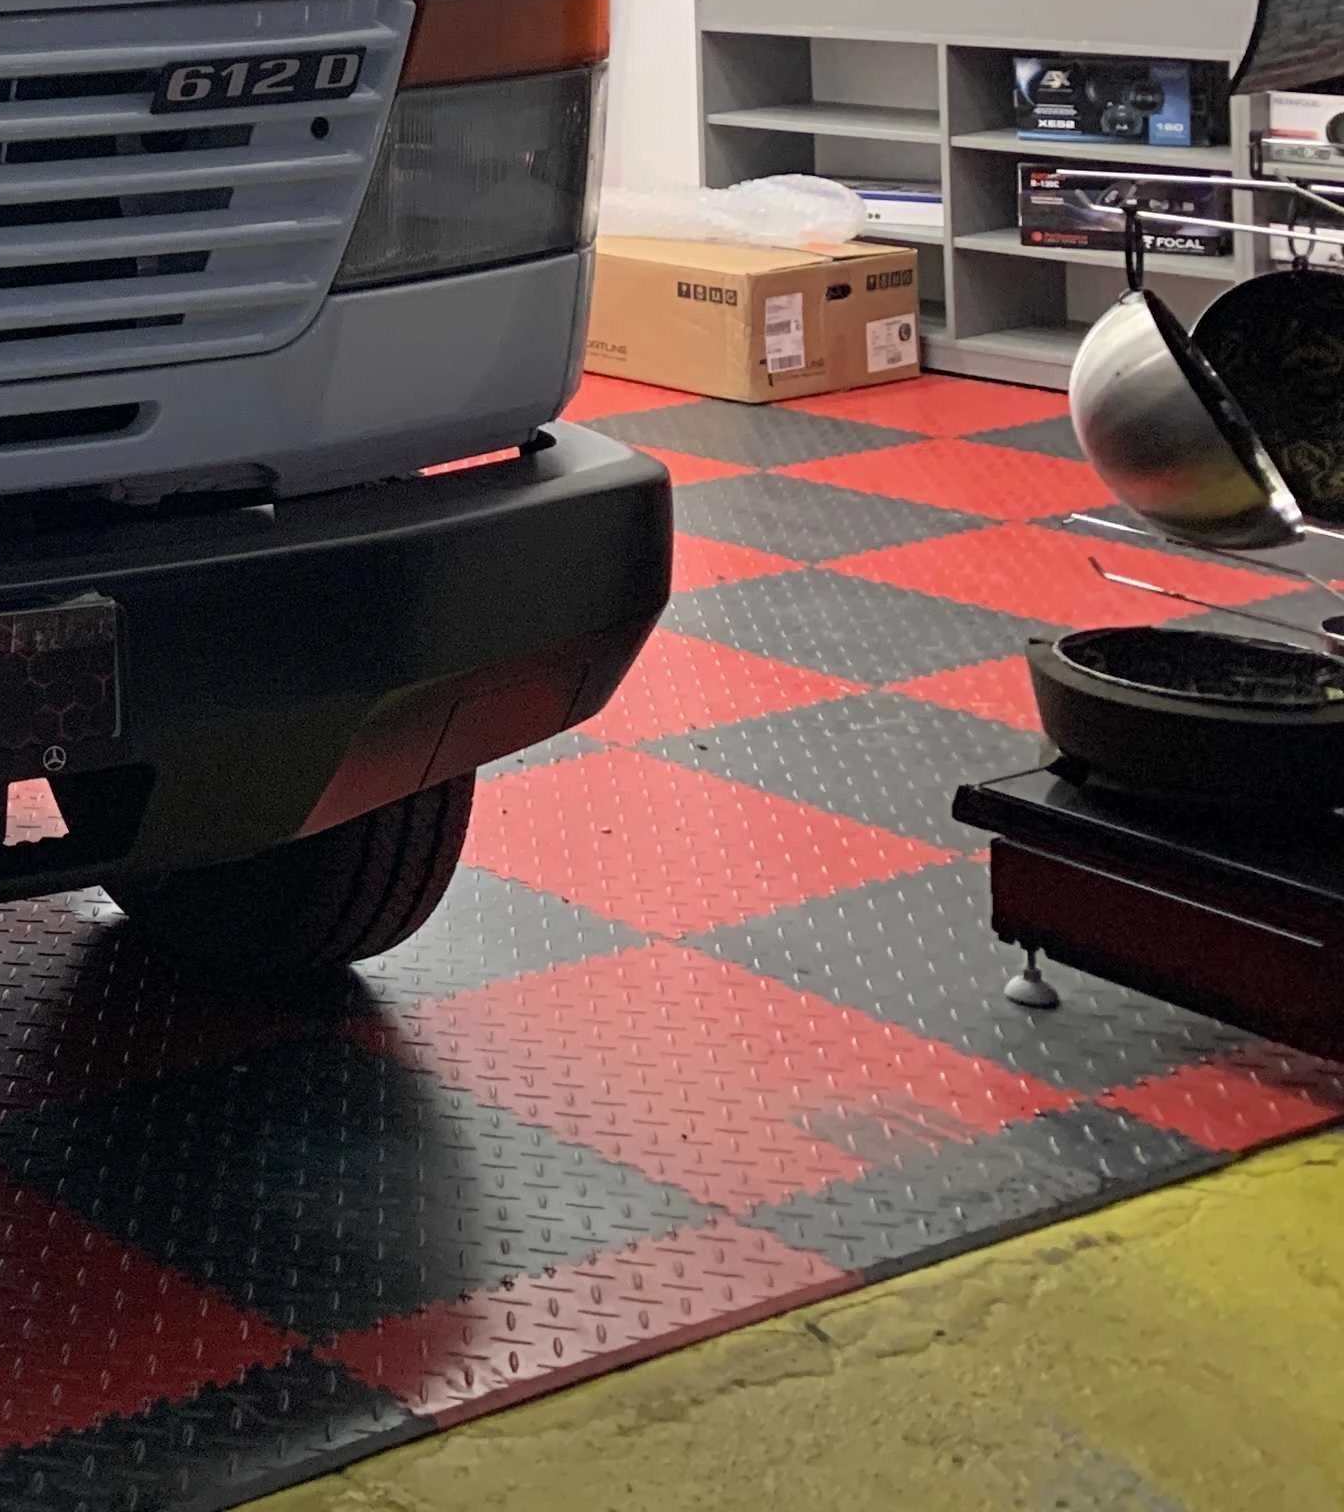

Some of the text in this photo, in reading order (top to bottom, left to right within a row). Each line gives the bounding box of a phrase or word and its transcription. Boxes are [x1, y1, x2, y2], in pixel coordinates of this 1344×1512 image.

[165, 54, 359, 103] 612 D
[1157, 237, 1205, 250] FOCAL
